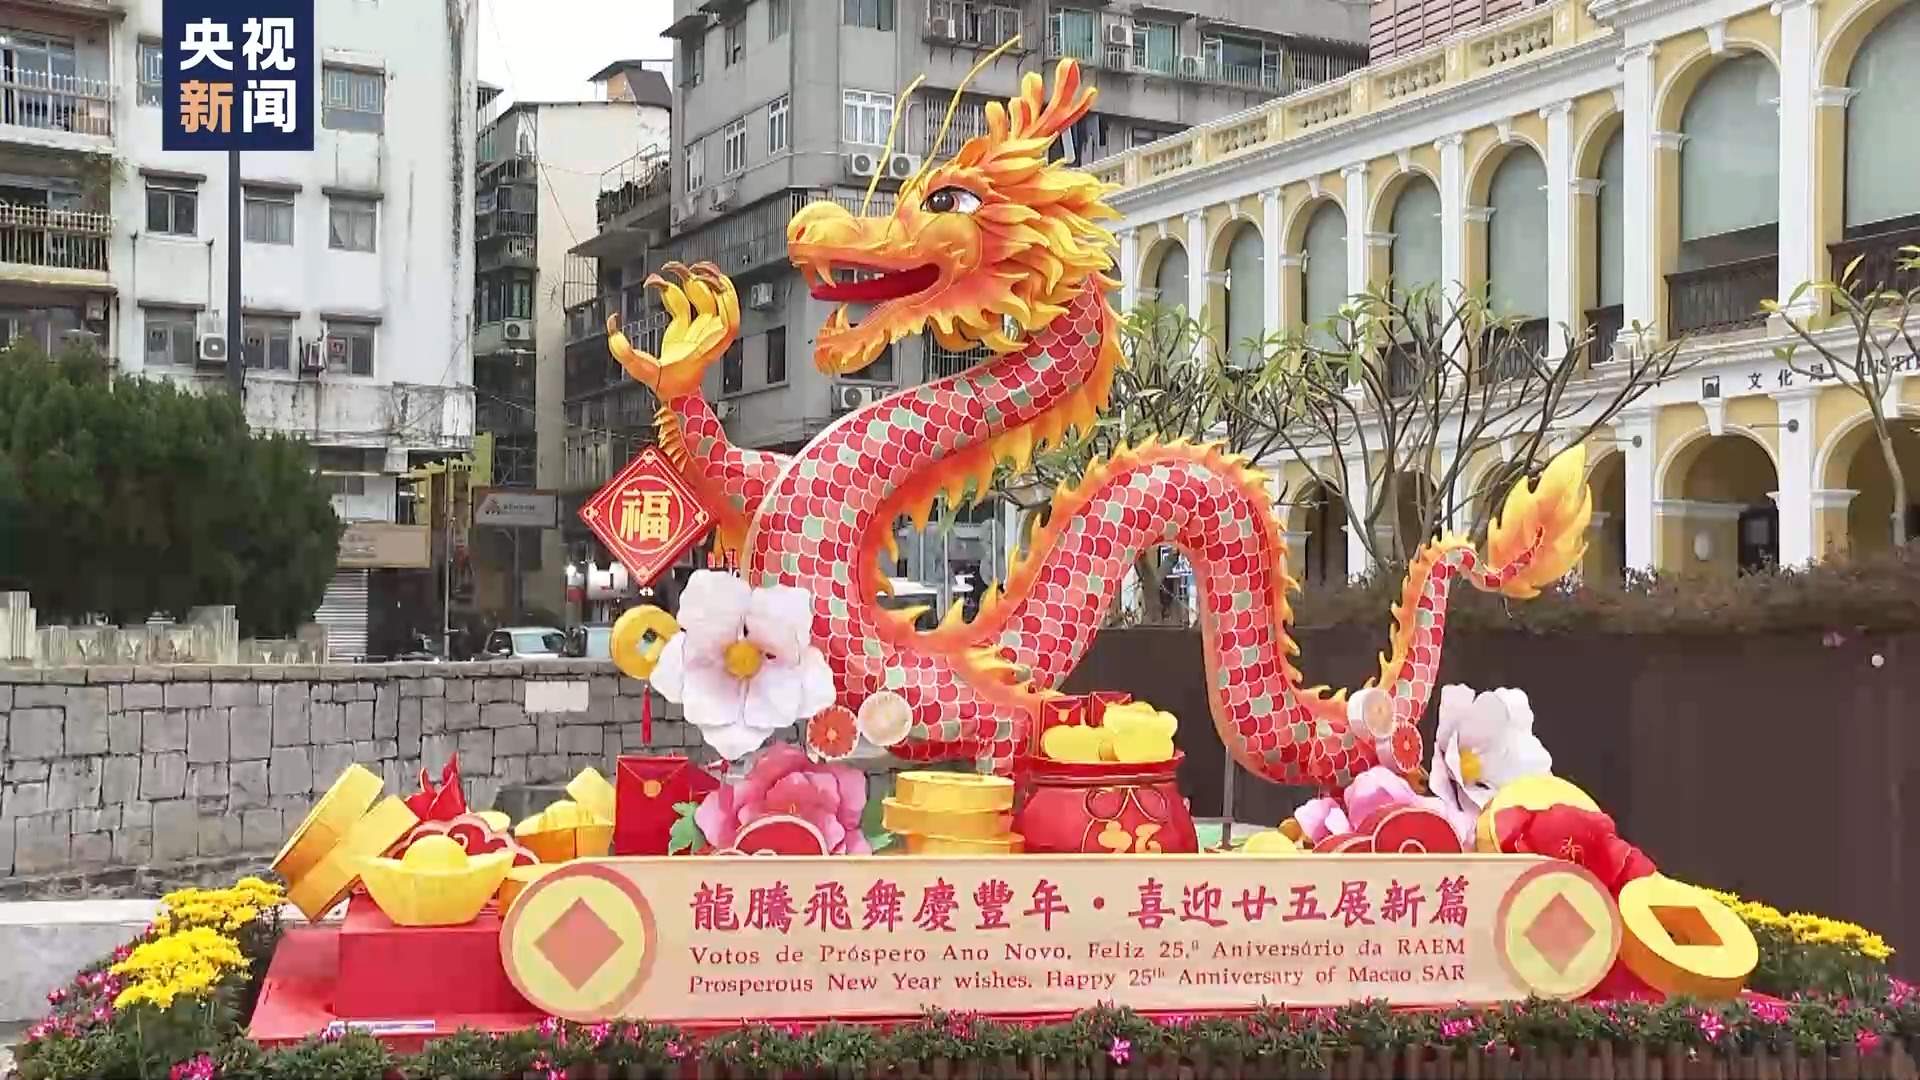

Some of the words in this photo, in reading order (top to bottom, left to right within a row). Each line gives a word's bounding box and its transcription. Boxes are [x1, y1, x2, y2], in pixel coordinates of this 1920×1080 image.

[619, 489, 673, 543] 福
[689, 946, 760, 965] Votos
[776, 945, 804, 963] de
[820, 944, 927, 966] Próspero
[943, 944, 989, 961] Ano
[1089, 941, 1145, 959] Feliz
[1212, 939, 1344, 959] Aniversário
[1358, 939, 1382, 957] da
[1398, 938, 1465, 955] RAEM
[689, 975, 813, 996] Prosperous
[828, 973, 878, 993] New
[892, 972, 942, 991] Year
[1047, 970, 1116, 990] Happy
[1179, 968, 1304, 987] Anniversary
[1315, 965, 1337, 984] of
[1349, 966, 1412, 983] Macao
[1422, 964, 1465, 982] SAR
